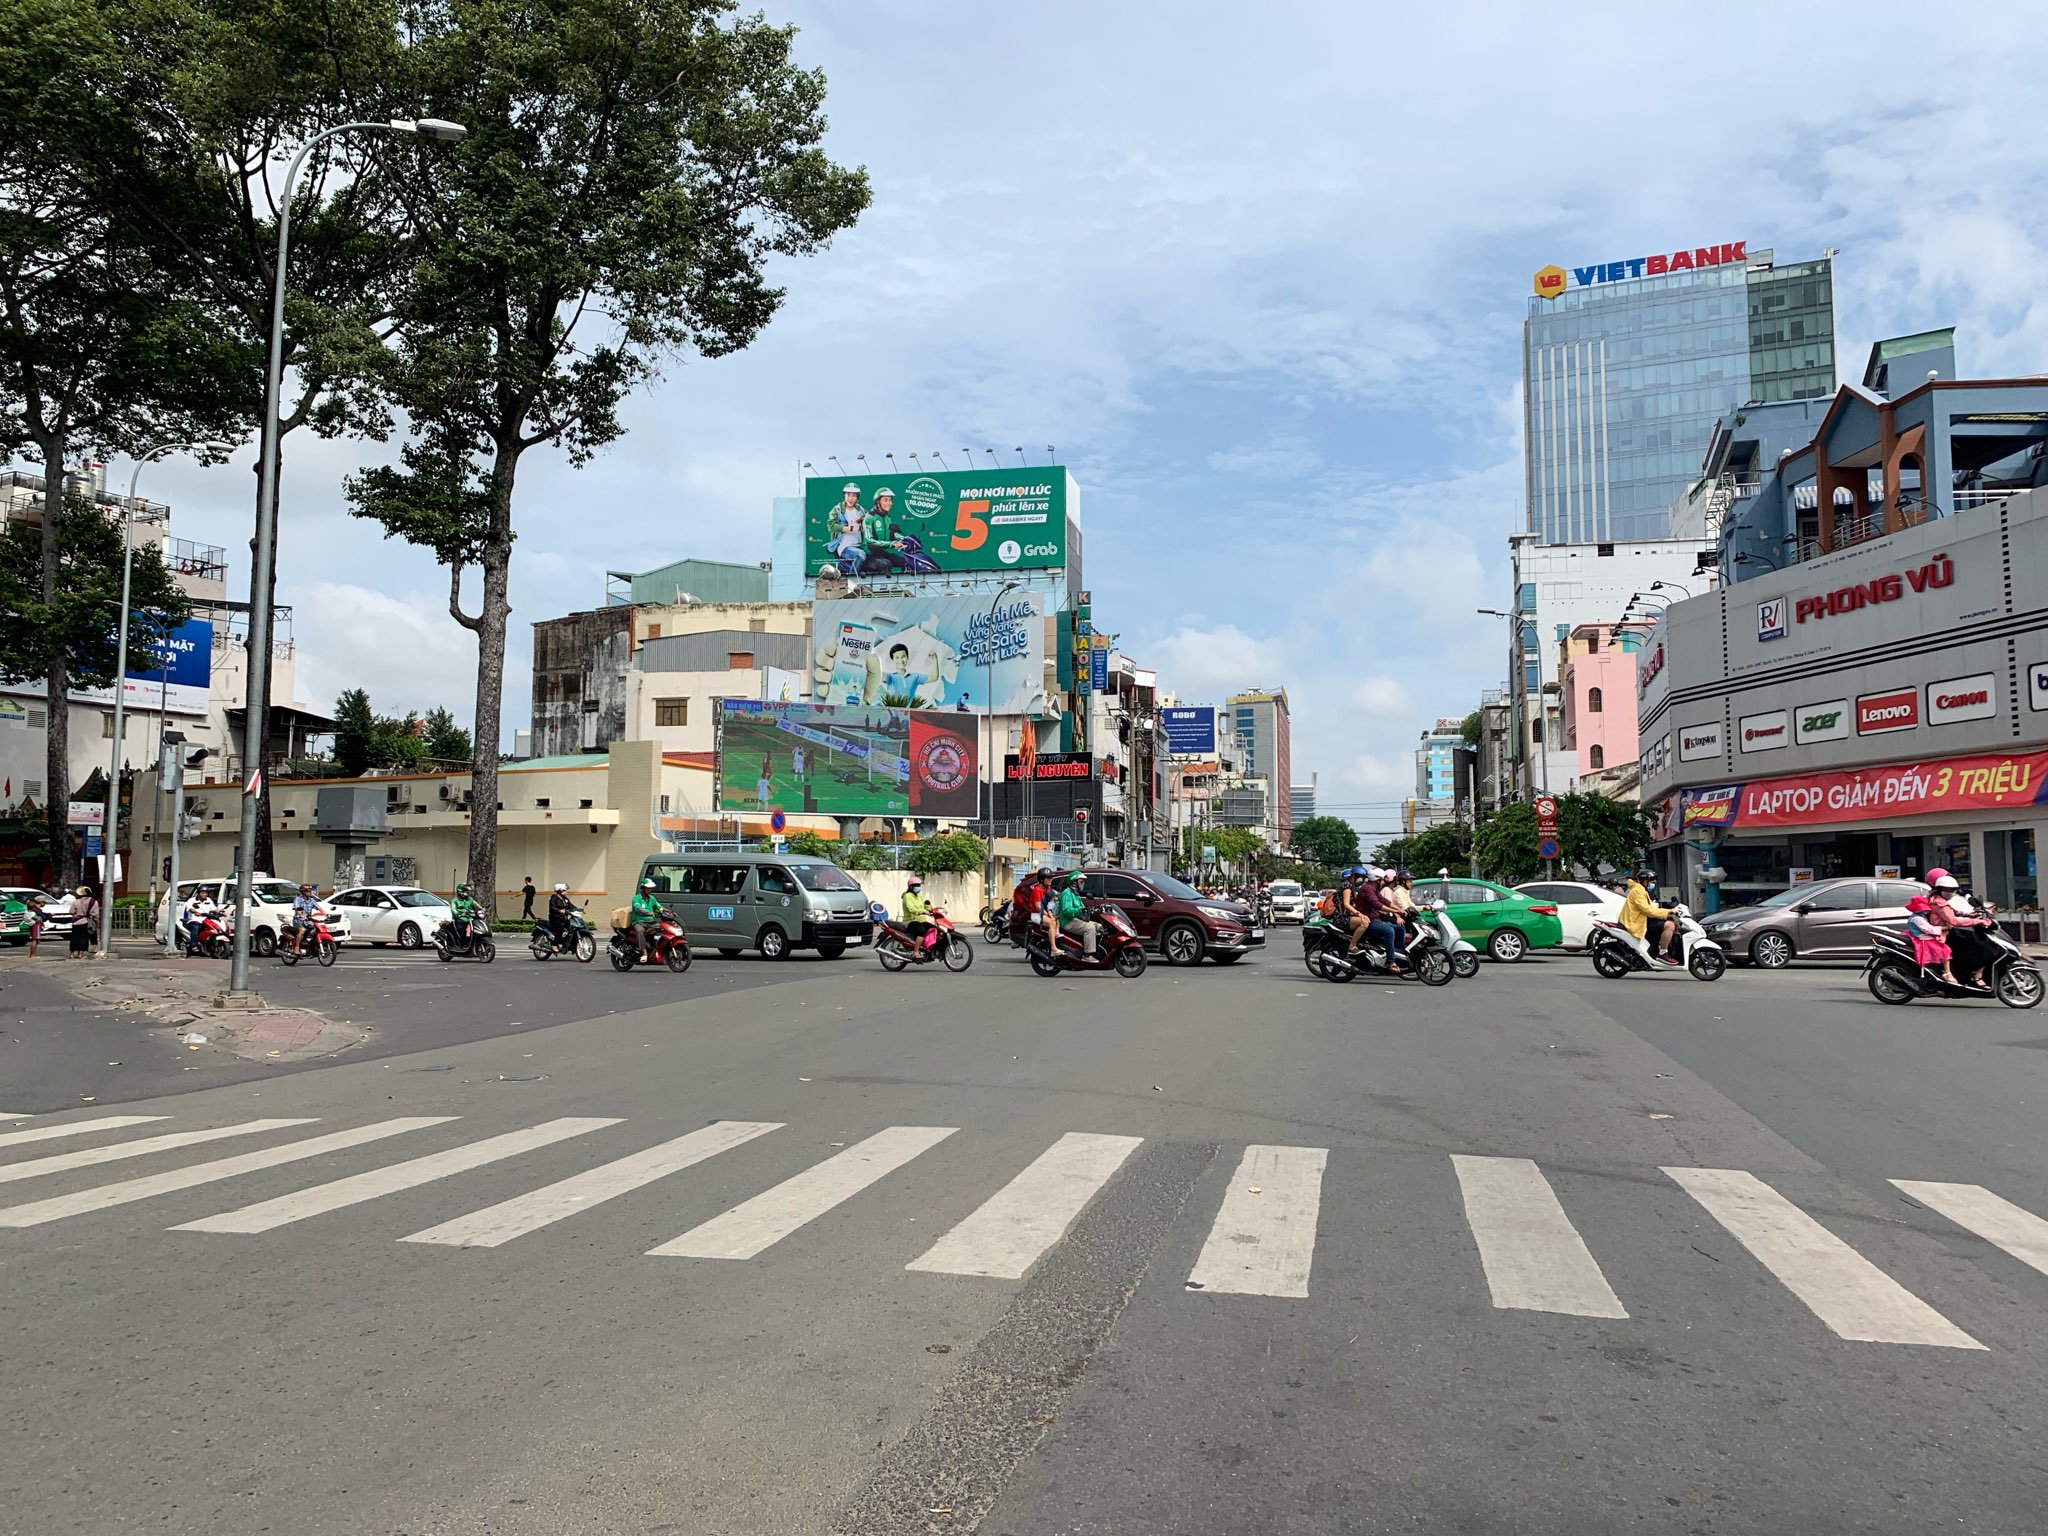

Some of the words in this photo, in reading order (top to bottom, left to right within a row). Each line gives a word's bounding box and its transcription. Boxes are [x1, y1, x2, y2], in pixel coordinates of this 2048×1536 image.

[1573, 240, 1748, 286] VIETBANK
[1539, 274, 1562, 288] VB
[960, 488, 983, 500] MỌI
[983, 486, 1005, 498] NƠI
[1005, 485, 1029, 498] MỌI
[1029, 483, 1052, 496] LÚC
[991, 502, 1017, 515] phút
[1018, 501, 1035, 512] lên
[1036, 502, 1049, 511] xe
[950, 499, 990, 551] 5
[1023, 541, 1058, 557] Grab
[1795, 573, 1903, 624] PHONG
[1904, 552, 1954, 594] VŨ
[1009, 600, 1034, 619] Mẽ
[841, 636, 871, 651] Nestlé
[1078, 592, 1089, 694] KARAOKE
[1761, 629, 1782, 640] COMPUTER
[169, 638, 196, 653] MẶT
[1935, 689, 1988, 710] Canon
[1172, 711, 1196, 719] ROBO
[1801, 710, 1842, 733] acer
[1861, 704, 1912, 723] Lenovo
[923, 746, 931, 755] HO
[930, 740, 940, 748] CHI
[940, 738, 956, 748] MINH
[954, 744, 965, 757] CITY
[1690, 733, 1717, 749] Kingston
[1036, 759, 1089, 778] NGUYÊN
[925, 774, 951, 790] FOOTBALL
[951, 774, 964, 787] CLUB
[1747, 786, 1823, 815] LAPTOP
[1827, 775, 1881, 809] GIẢM
[1883, 765, 1932, 803] ĐẾN
[1932, 767, 1953, 797] 3
[1958, 759, 2032, 801] TRIỆU
[710, 908, 732, 918] APEX
